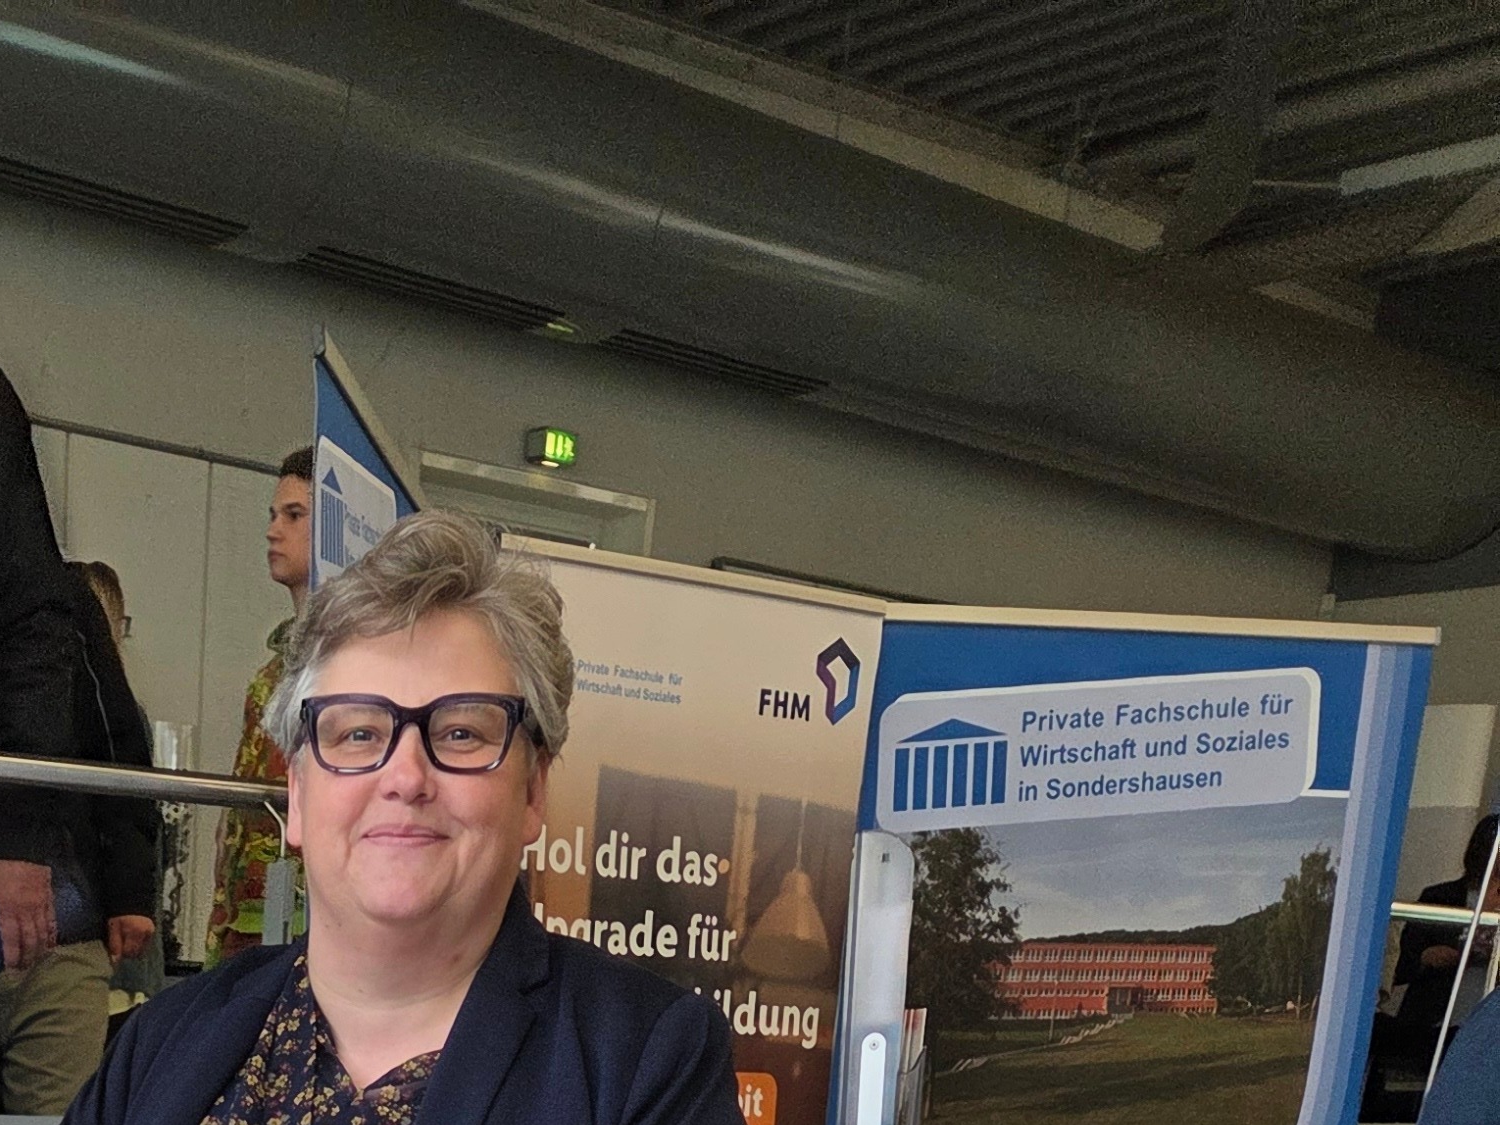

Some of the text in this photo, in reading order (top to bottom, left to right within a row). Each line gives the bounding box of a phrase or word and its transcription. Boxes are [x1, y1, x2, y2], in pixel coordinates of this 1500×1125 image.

[577, 679, 682, 704] Wirtschaft und Soziales
[613, 665, 664, 684] Fachschule
[758, 688, 811, 722] FHM
[1021, 694, 1294, 733] Private Fachschule für
[1019, 729, 1290, 767] Wirtschaft und Soziales
[1018, 771, 1223, 802] in Sondershausen
[595, 829, 647, 880] dir
[656, 835, 719, 887] das
[687, 913, 737, 962] für
